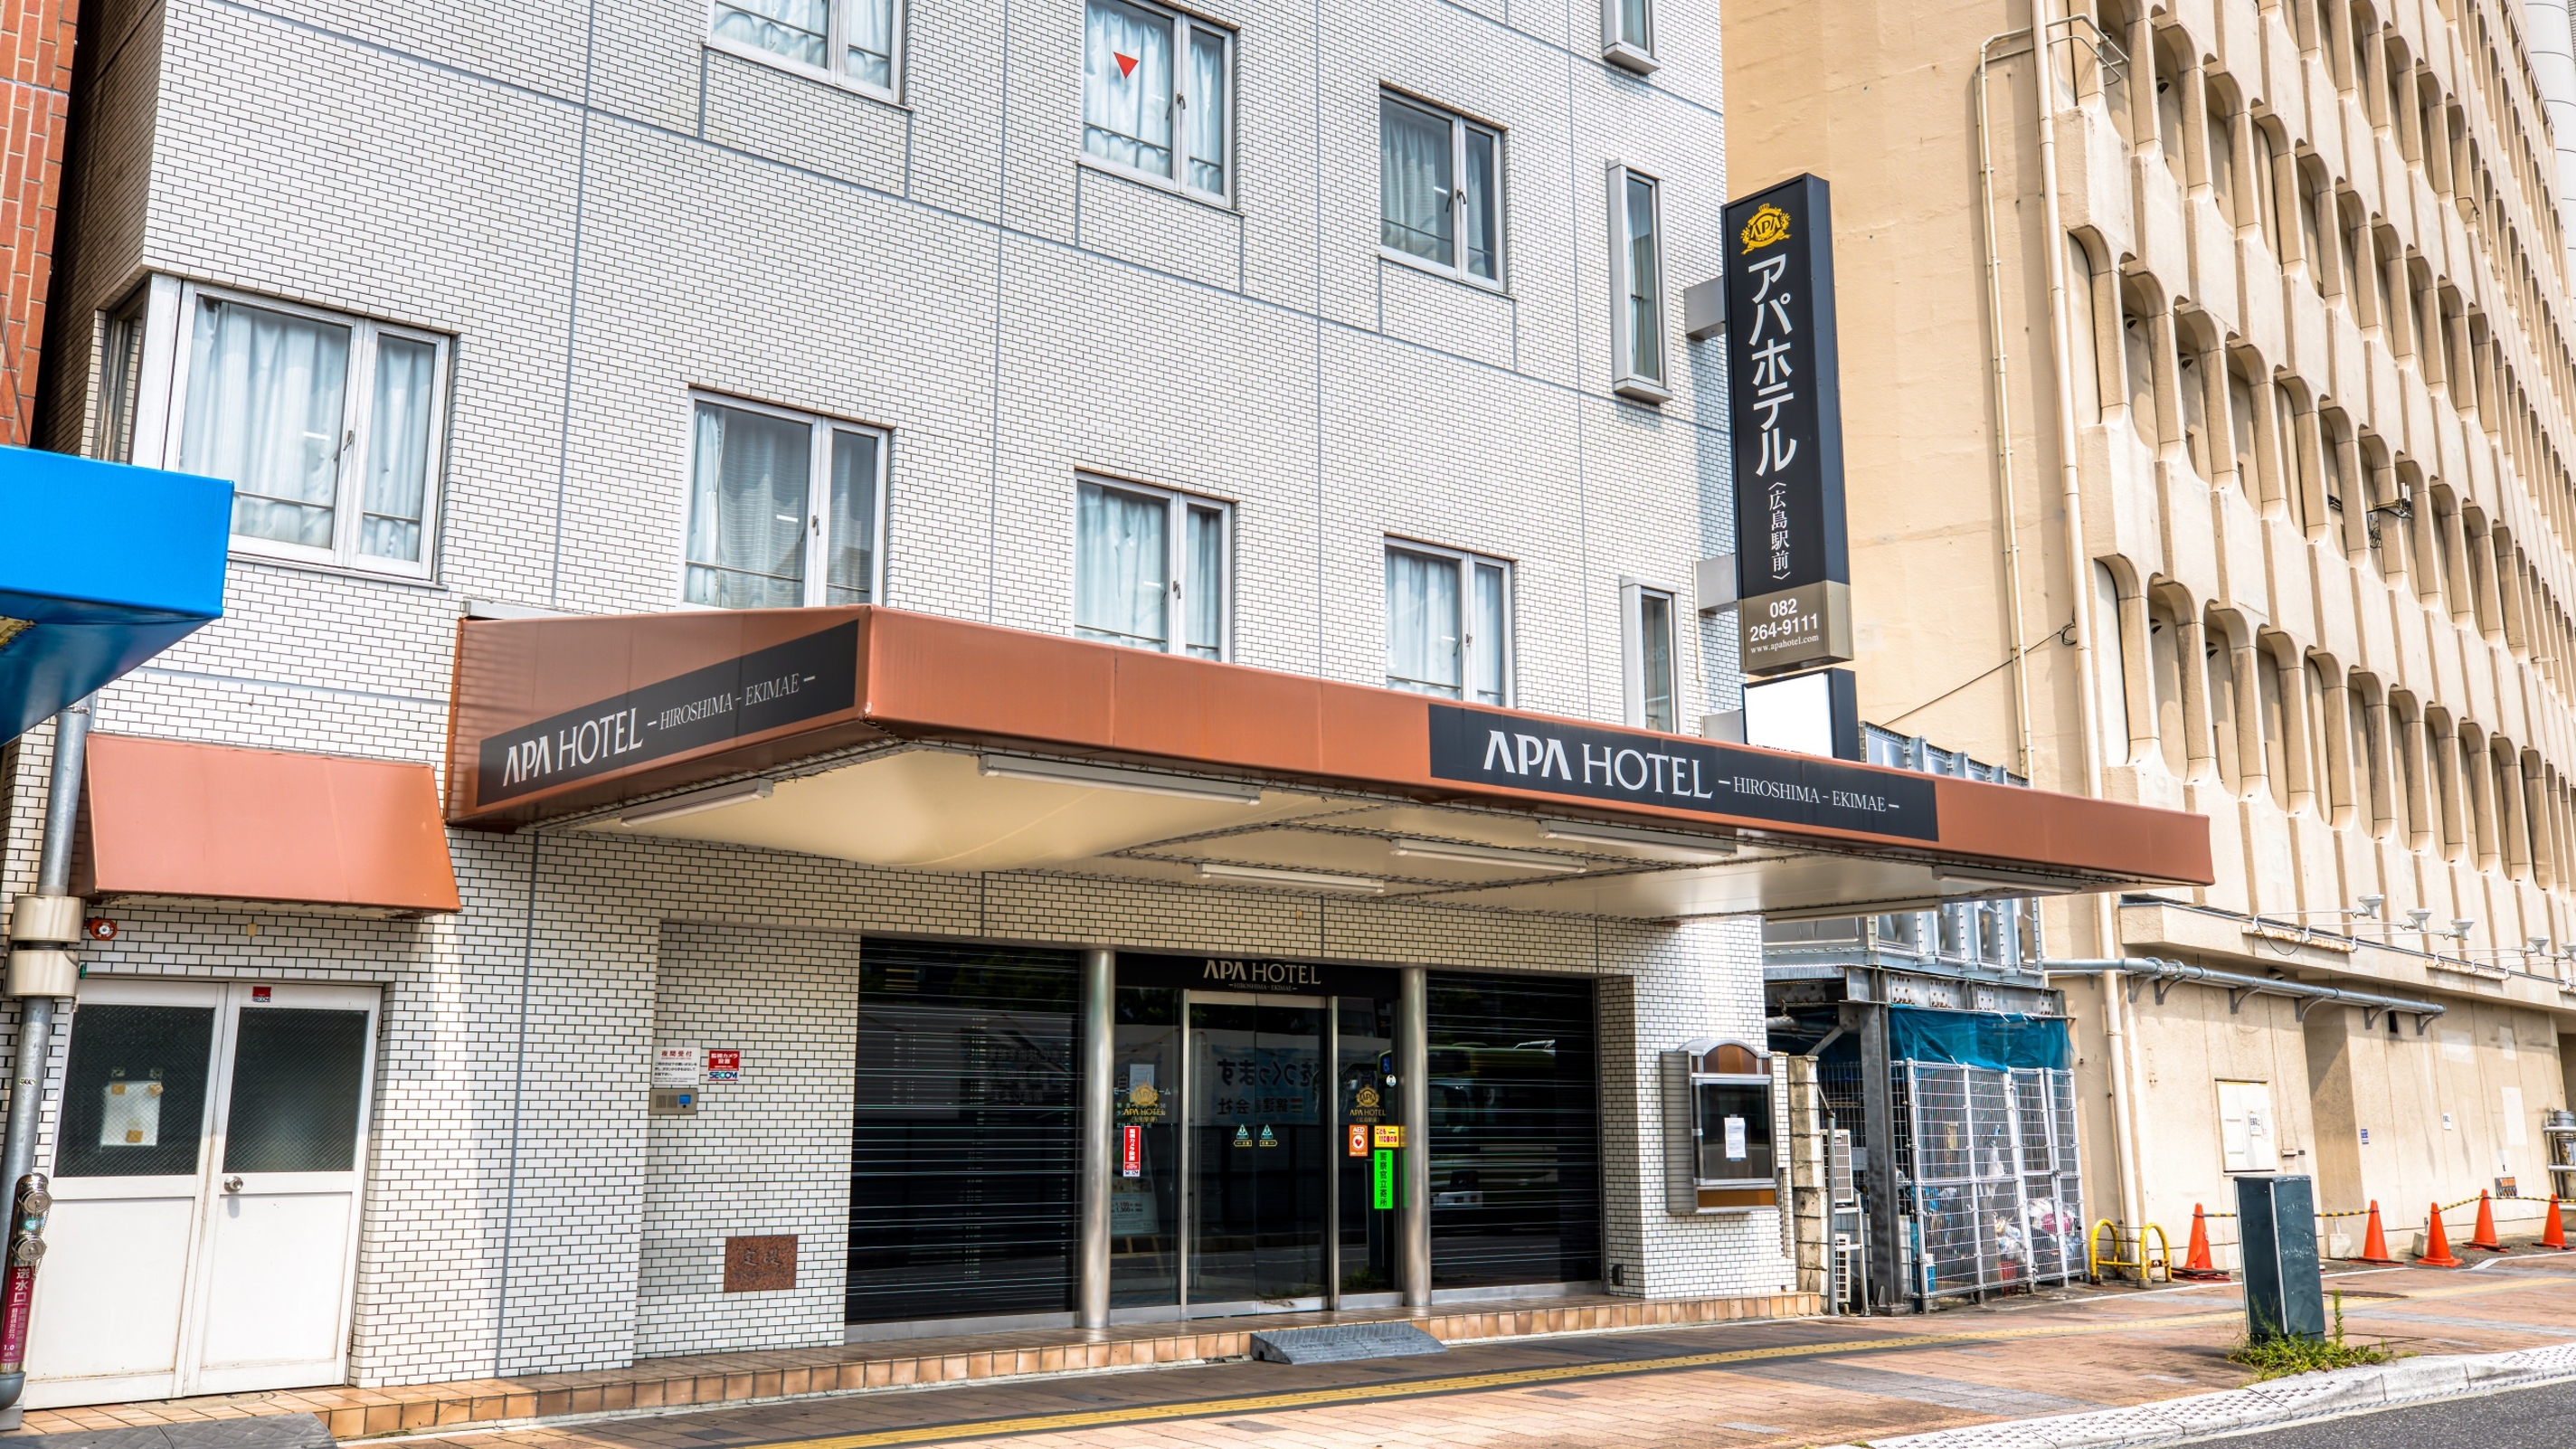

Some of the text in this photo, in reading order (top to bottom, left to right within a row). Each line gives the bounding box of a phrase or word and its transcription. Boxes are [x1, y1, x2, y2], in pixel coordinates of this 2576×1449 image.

[1748, 253, 1797, 477] アパホテル
[1769, 598, 1797, 618] 082
[1749, 612, 1818, 642] 264-9111
[1750, 634, 1819, 654] www.apahotel.com
[503, 672, 800, 787] APA HOTEL HIROSHIMA EKIMAE
[1483, 730, 1887, 813] APA HOTEL HIROSHIMA EKIMAE
[1203, 959, 1321, 985] APA HOTEL
[1379, 1151, 1387, 1207] 警察官立寄所
[14, 1268, 30, 1302] 送水口
